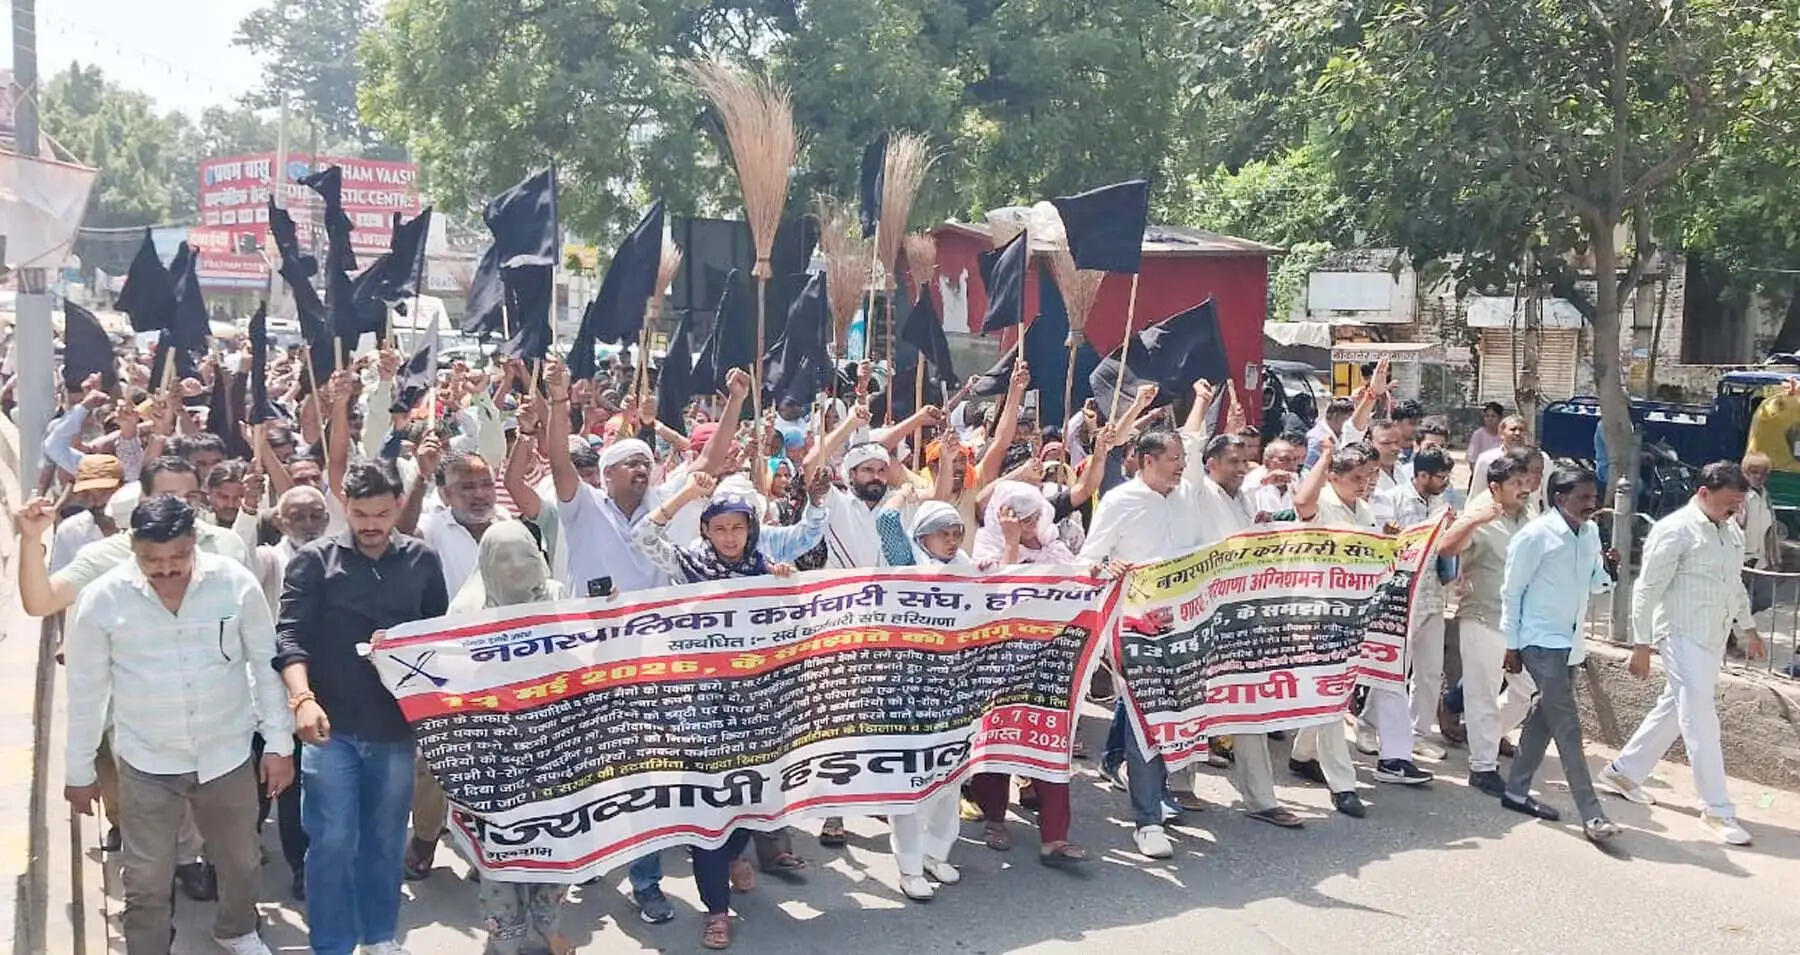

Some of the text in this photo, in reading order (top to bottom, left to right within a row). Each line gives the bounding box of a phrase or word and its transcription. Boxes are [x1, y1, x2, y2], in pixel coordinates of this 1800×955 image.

[470, 611, 737, 662] नगरपालिका
[749, 584, 887, 625] कर्मचारी
[897, 587, 972, 611] संघ,
[772, 627, 798, 642] सर्व
[860, 610, 887, 625] संघ
[891, 611, 957, 628] हरियाणा
[1125, 643, 1163, 658] 13
[1236, 603, 1257, 621] के
[1261, 600, 1353, 617] समझौते
[512, 674, 568, 701] मई
[581, 661, 716, 685] 2026,
[731, 654, 766, 669] के
[643, 683, 659, 695] को
[663, 683, 696, 694] पक्का
[643, 710, 660, 721] को
[701, 706, 720, 717] पर
[1011, 709, 1025, 723] 7
[1028, 711, 1041, 726] व
[1045, 715, 1057, 730] 8
[1029, 731, 1069, 749] 2026
[447, 767, 482, 784] सभी
[644, 733, 662, 746] को
[480, 751, 497, 765] को
[463, 784, 495, 798] दिया
